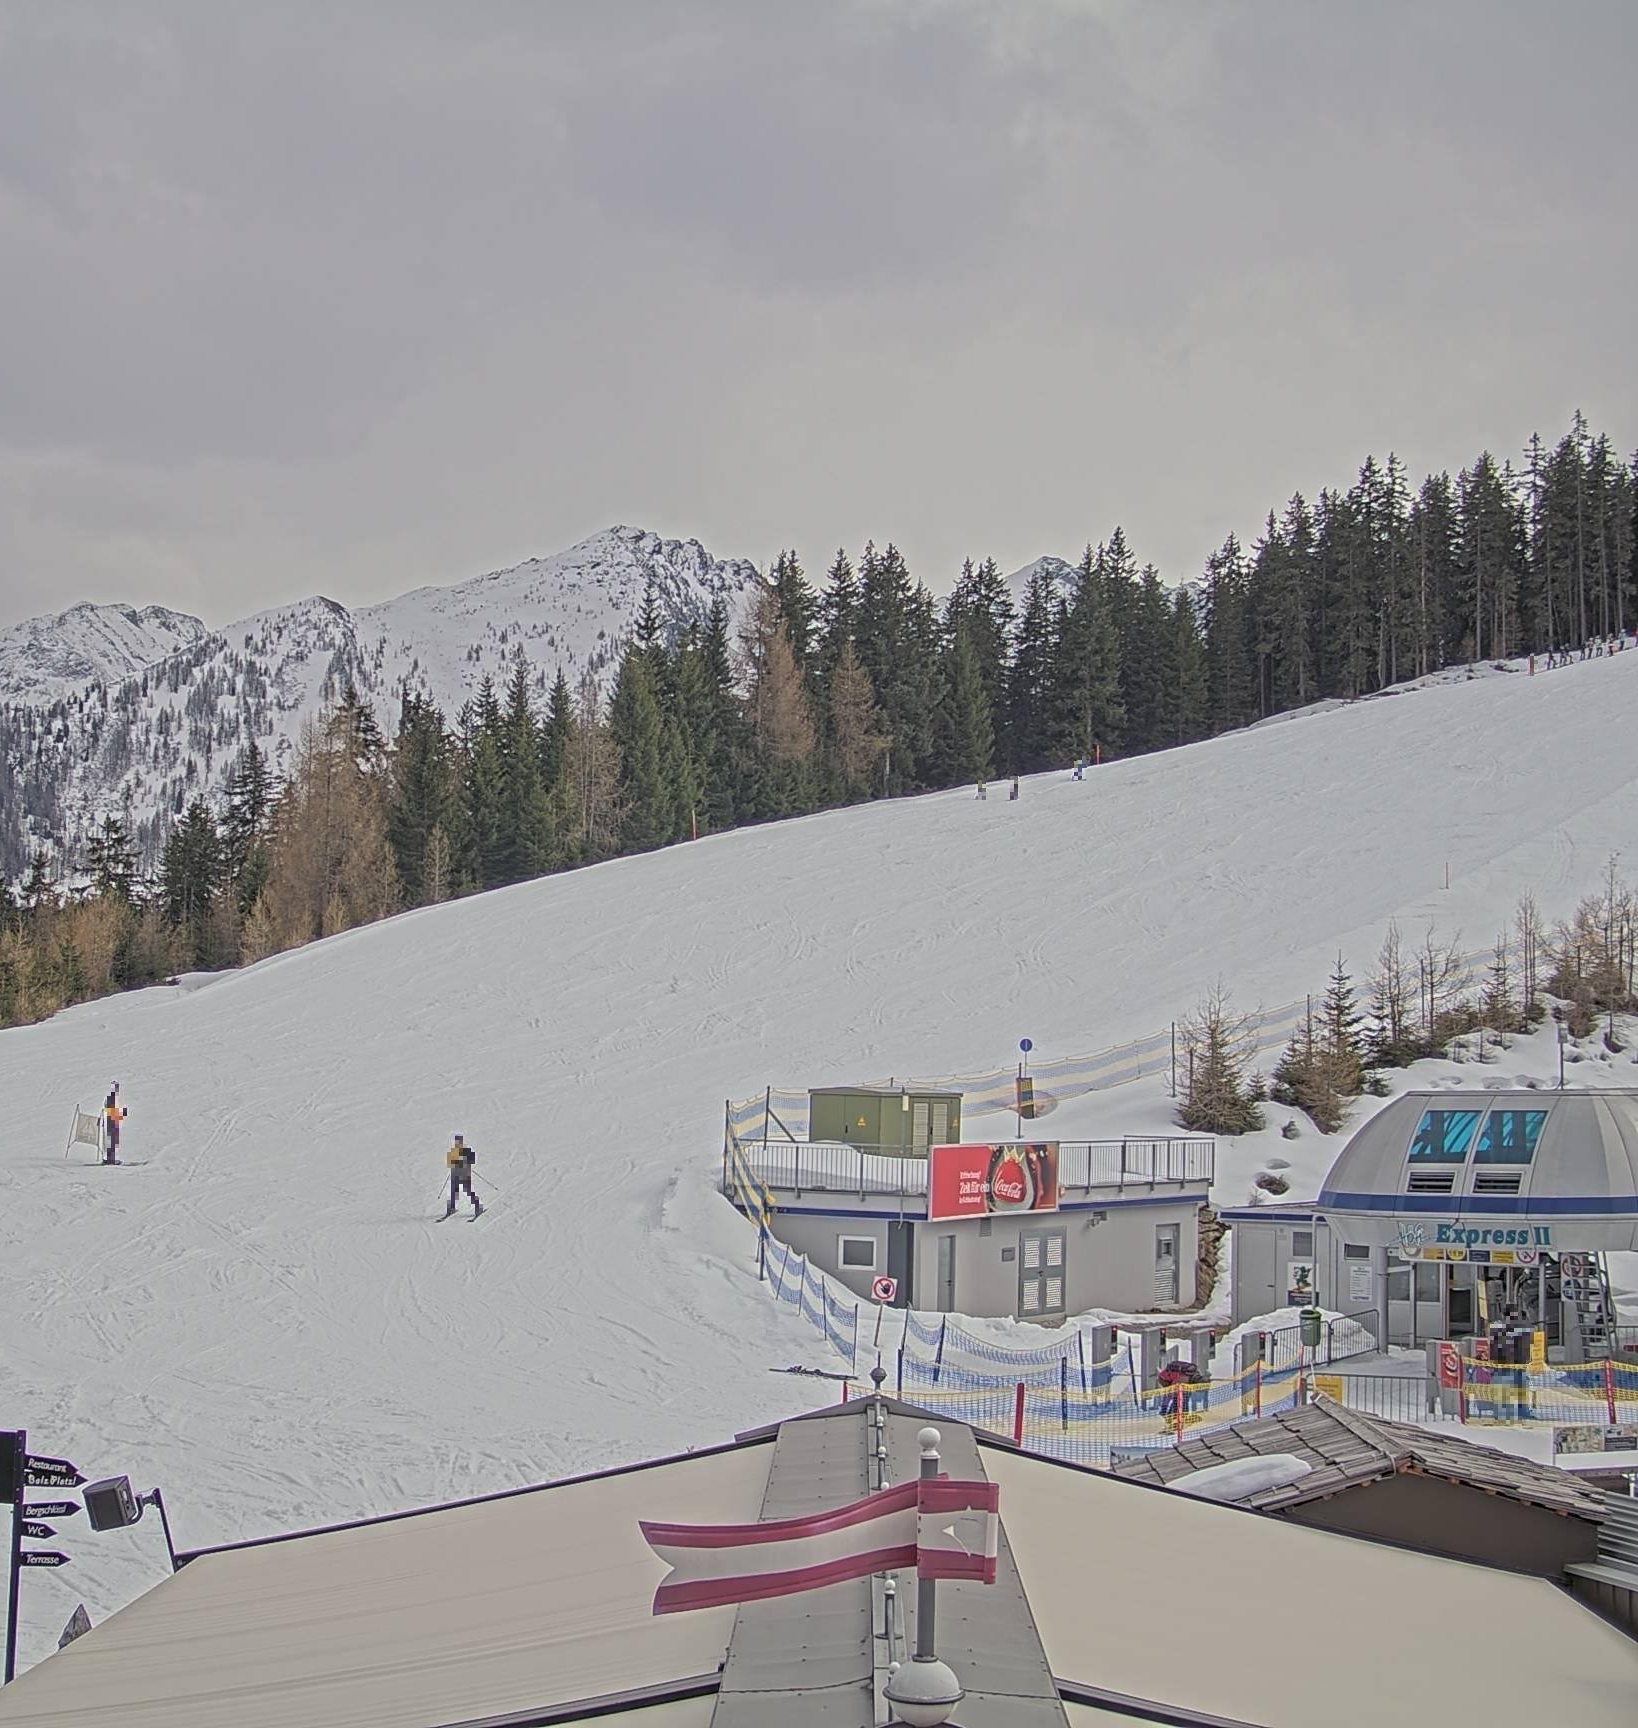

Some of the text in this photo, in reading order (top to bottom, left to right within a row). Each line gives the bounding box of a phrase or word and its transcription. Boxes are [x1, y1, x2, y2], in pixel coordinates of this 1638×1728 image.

[1436, 1223, 1529, 1248] Express
[1533, 1226, 1552, 1246] II
[27, 1458, 67, 1473] Restaurant
[27, 1525, 45, 1535] WC
[26, 1554, 60, 1564] Terrasse
